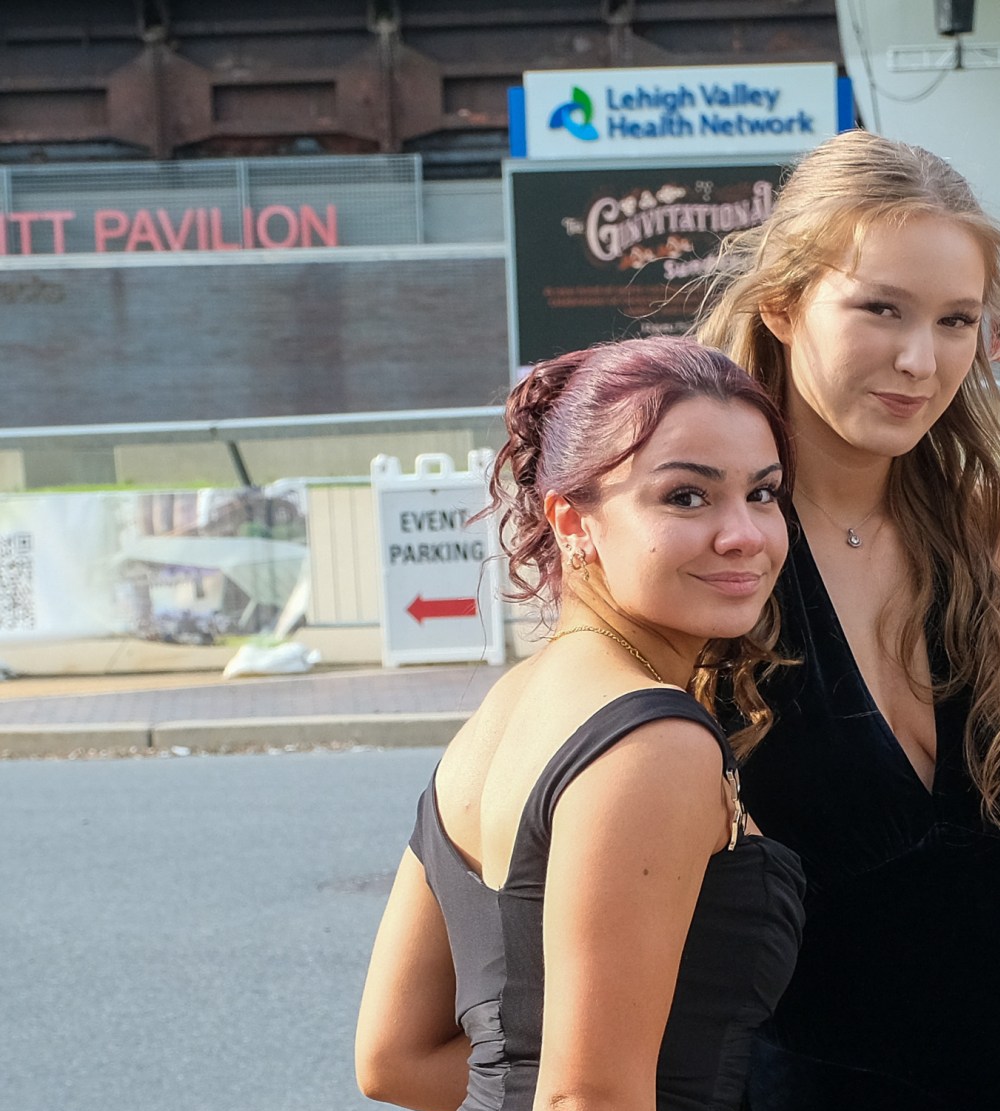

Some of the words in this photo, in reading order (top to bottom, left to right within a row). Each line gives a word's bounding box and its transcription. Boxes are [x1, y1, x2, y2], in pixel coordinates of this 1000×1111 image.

[606, 86, 695, 113] Lehigh
[699, 83, 780, 112] Valley
[607, 114, 694, 138] Health
[699, 108, 814, 135] Network
[94, 203, 338, 252] PAVILION
[401, 508, 468, 532] EVENT
[389, 542, 484, 565] PARKING
